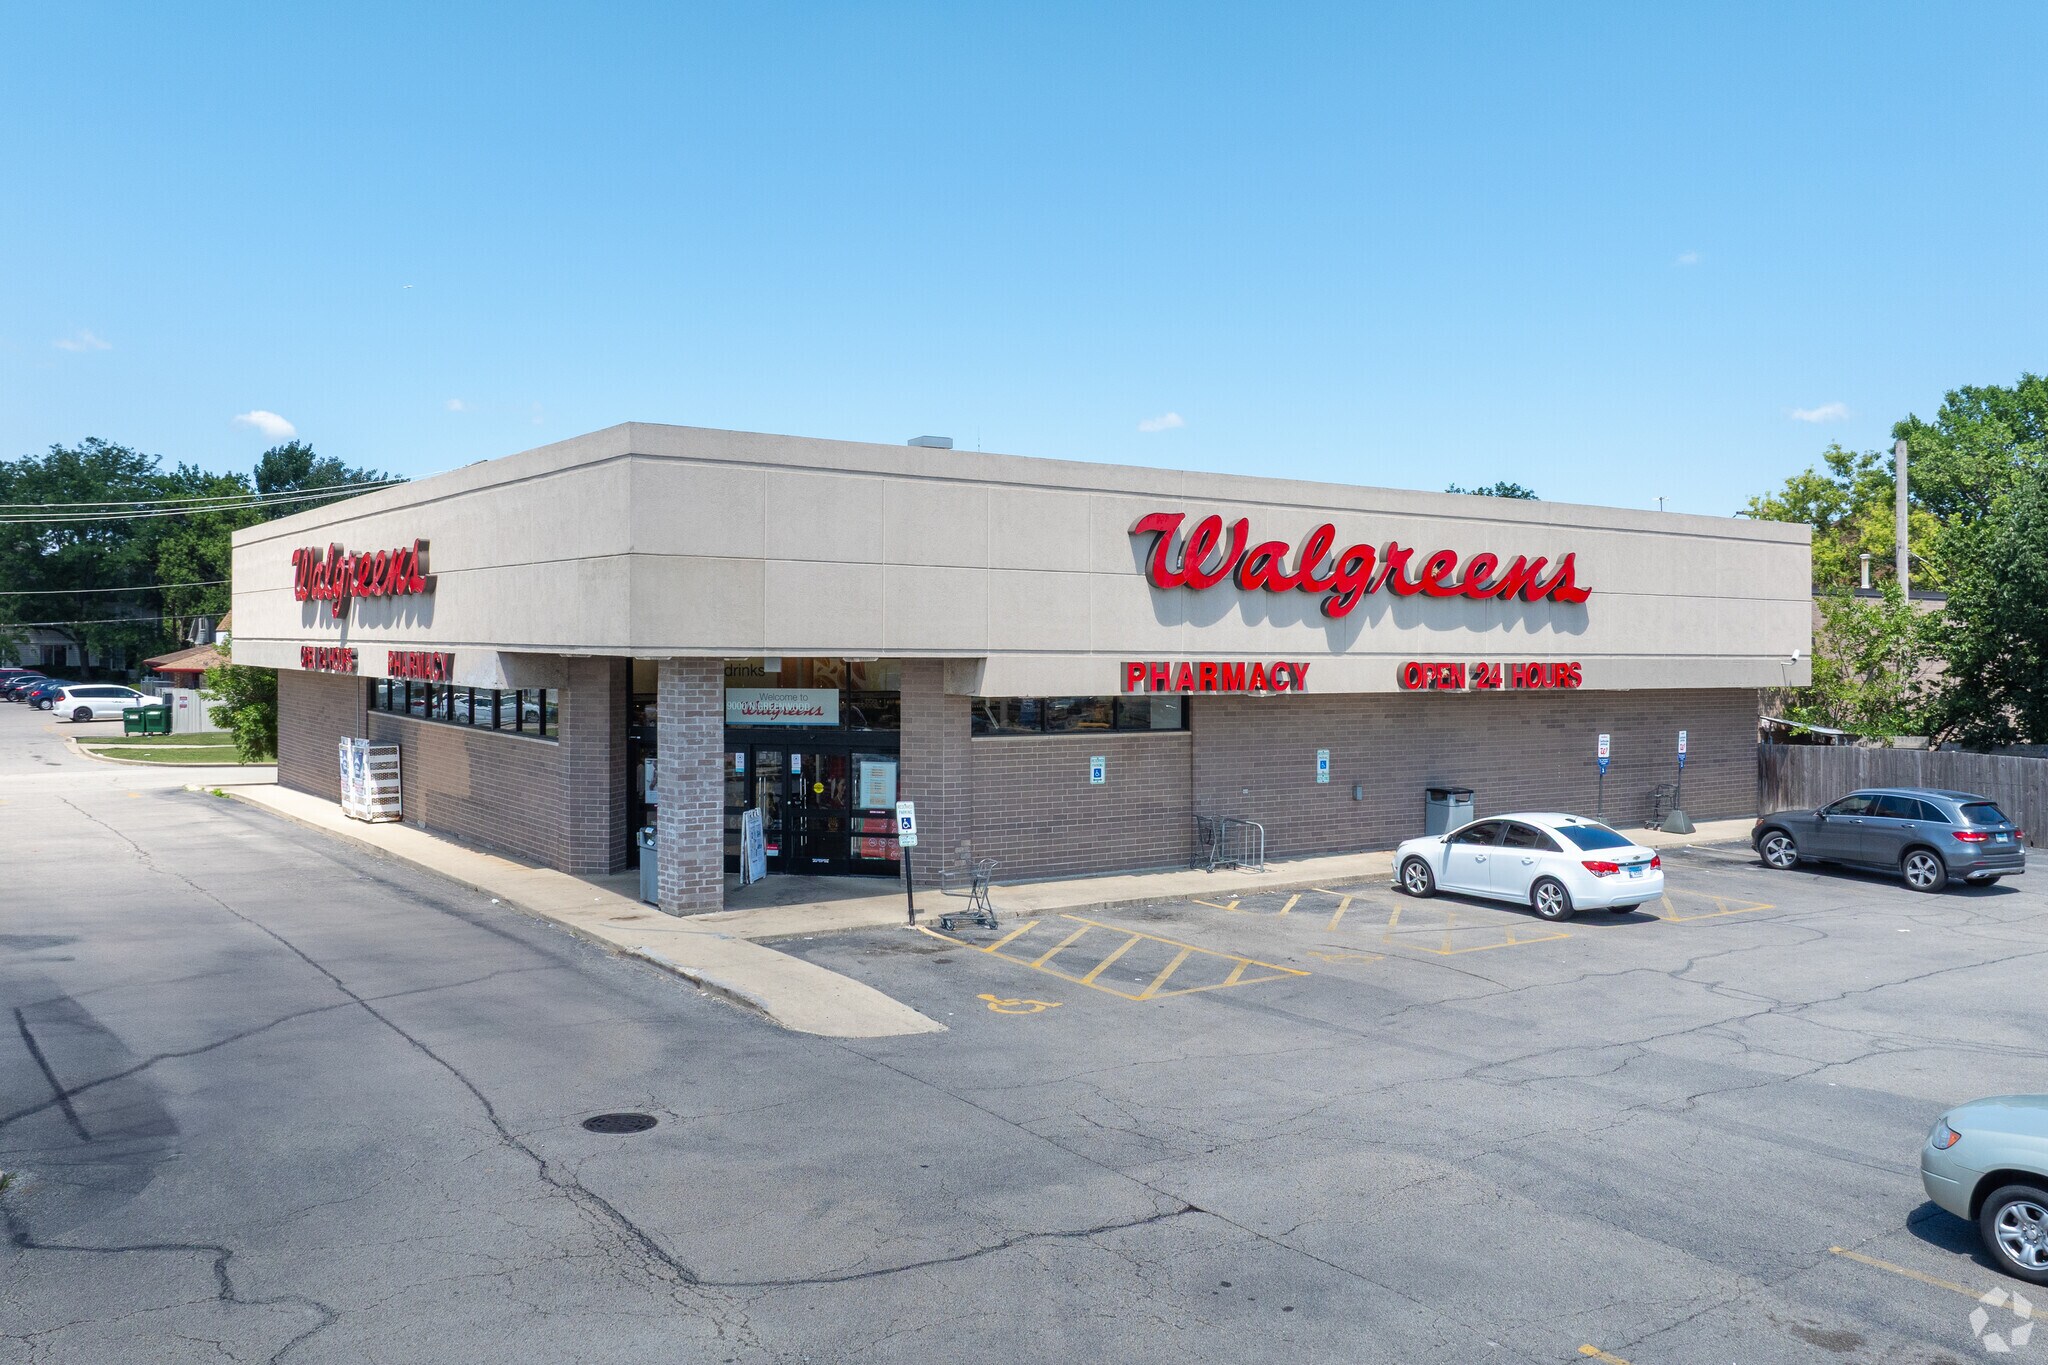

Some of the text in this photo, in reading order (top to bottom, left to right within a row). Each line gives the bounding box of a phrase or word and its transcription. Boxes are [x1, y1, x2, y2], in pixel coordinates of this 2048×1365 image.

[292, 538, 430, 619] Walgreens
[1129, 511, 1592, 618] Walgreens
[387, 651, 449, 681] PHARMACY
[724, 663, 766, 677] drinks
[1124, 661, 1311, 692] PHARMACY
[1401, 661, 1583, 690] OPEN 24 HOURS
[741, 701, 824, 720] Walgreens
[760, 692, 809, 702] Welcome to
